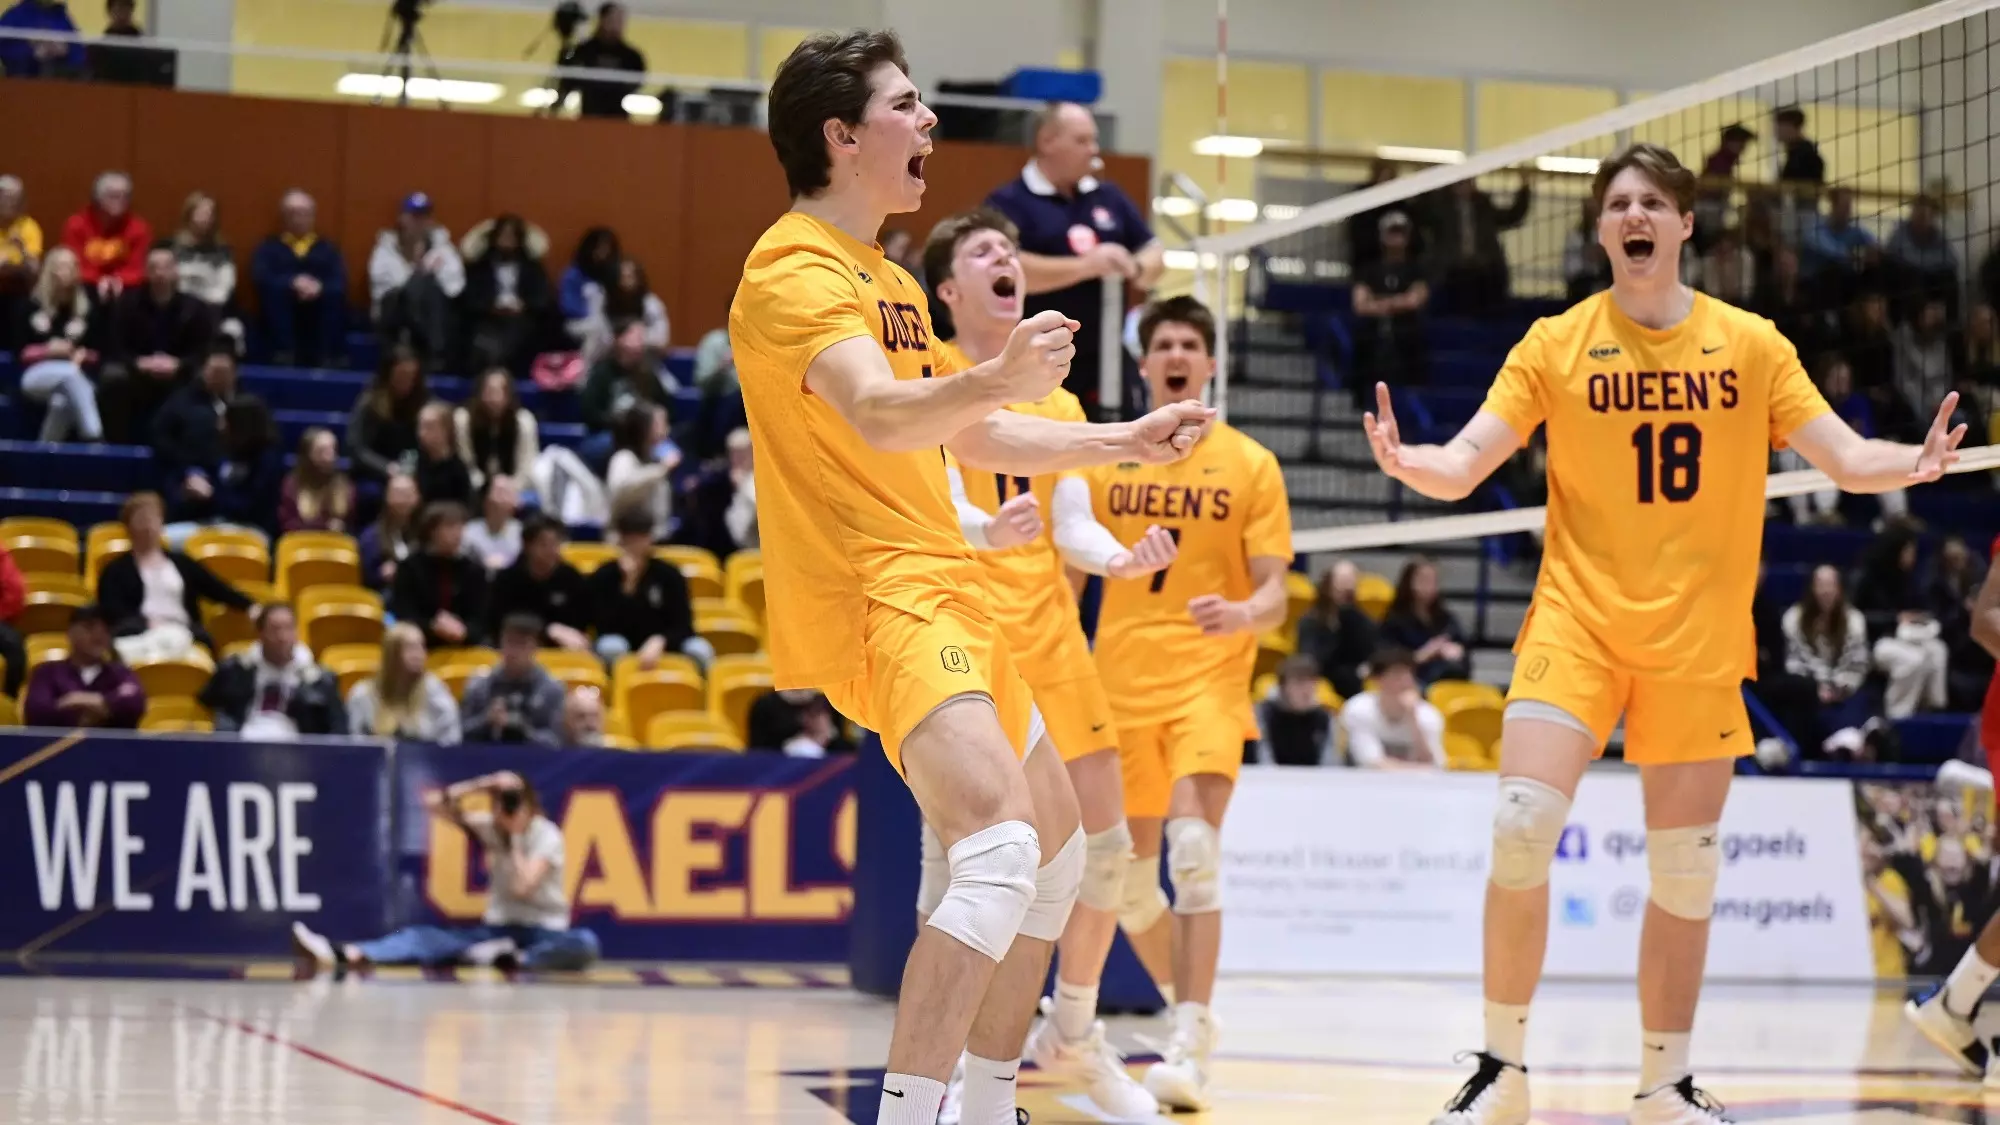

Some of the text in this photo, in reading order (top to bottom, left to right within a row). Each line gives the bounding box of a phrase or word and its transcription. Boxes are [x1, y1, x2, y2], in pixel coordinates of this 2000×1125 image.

[1588, 368, 1739, 414] QUEEN'S
[1631, 422, 1702, 504] 18
[1109, 483, 1231, 522] QUEEN'S
[25, 780, 322, 912] WE ARE
[1602, 827, 1807, 863] qugaels
[1608, 886, 1835, 930] @nsgaels
